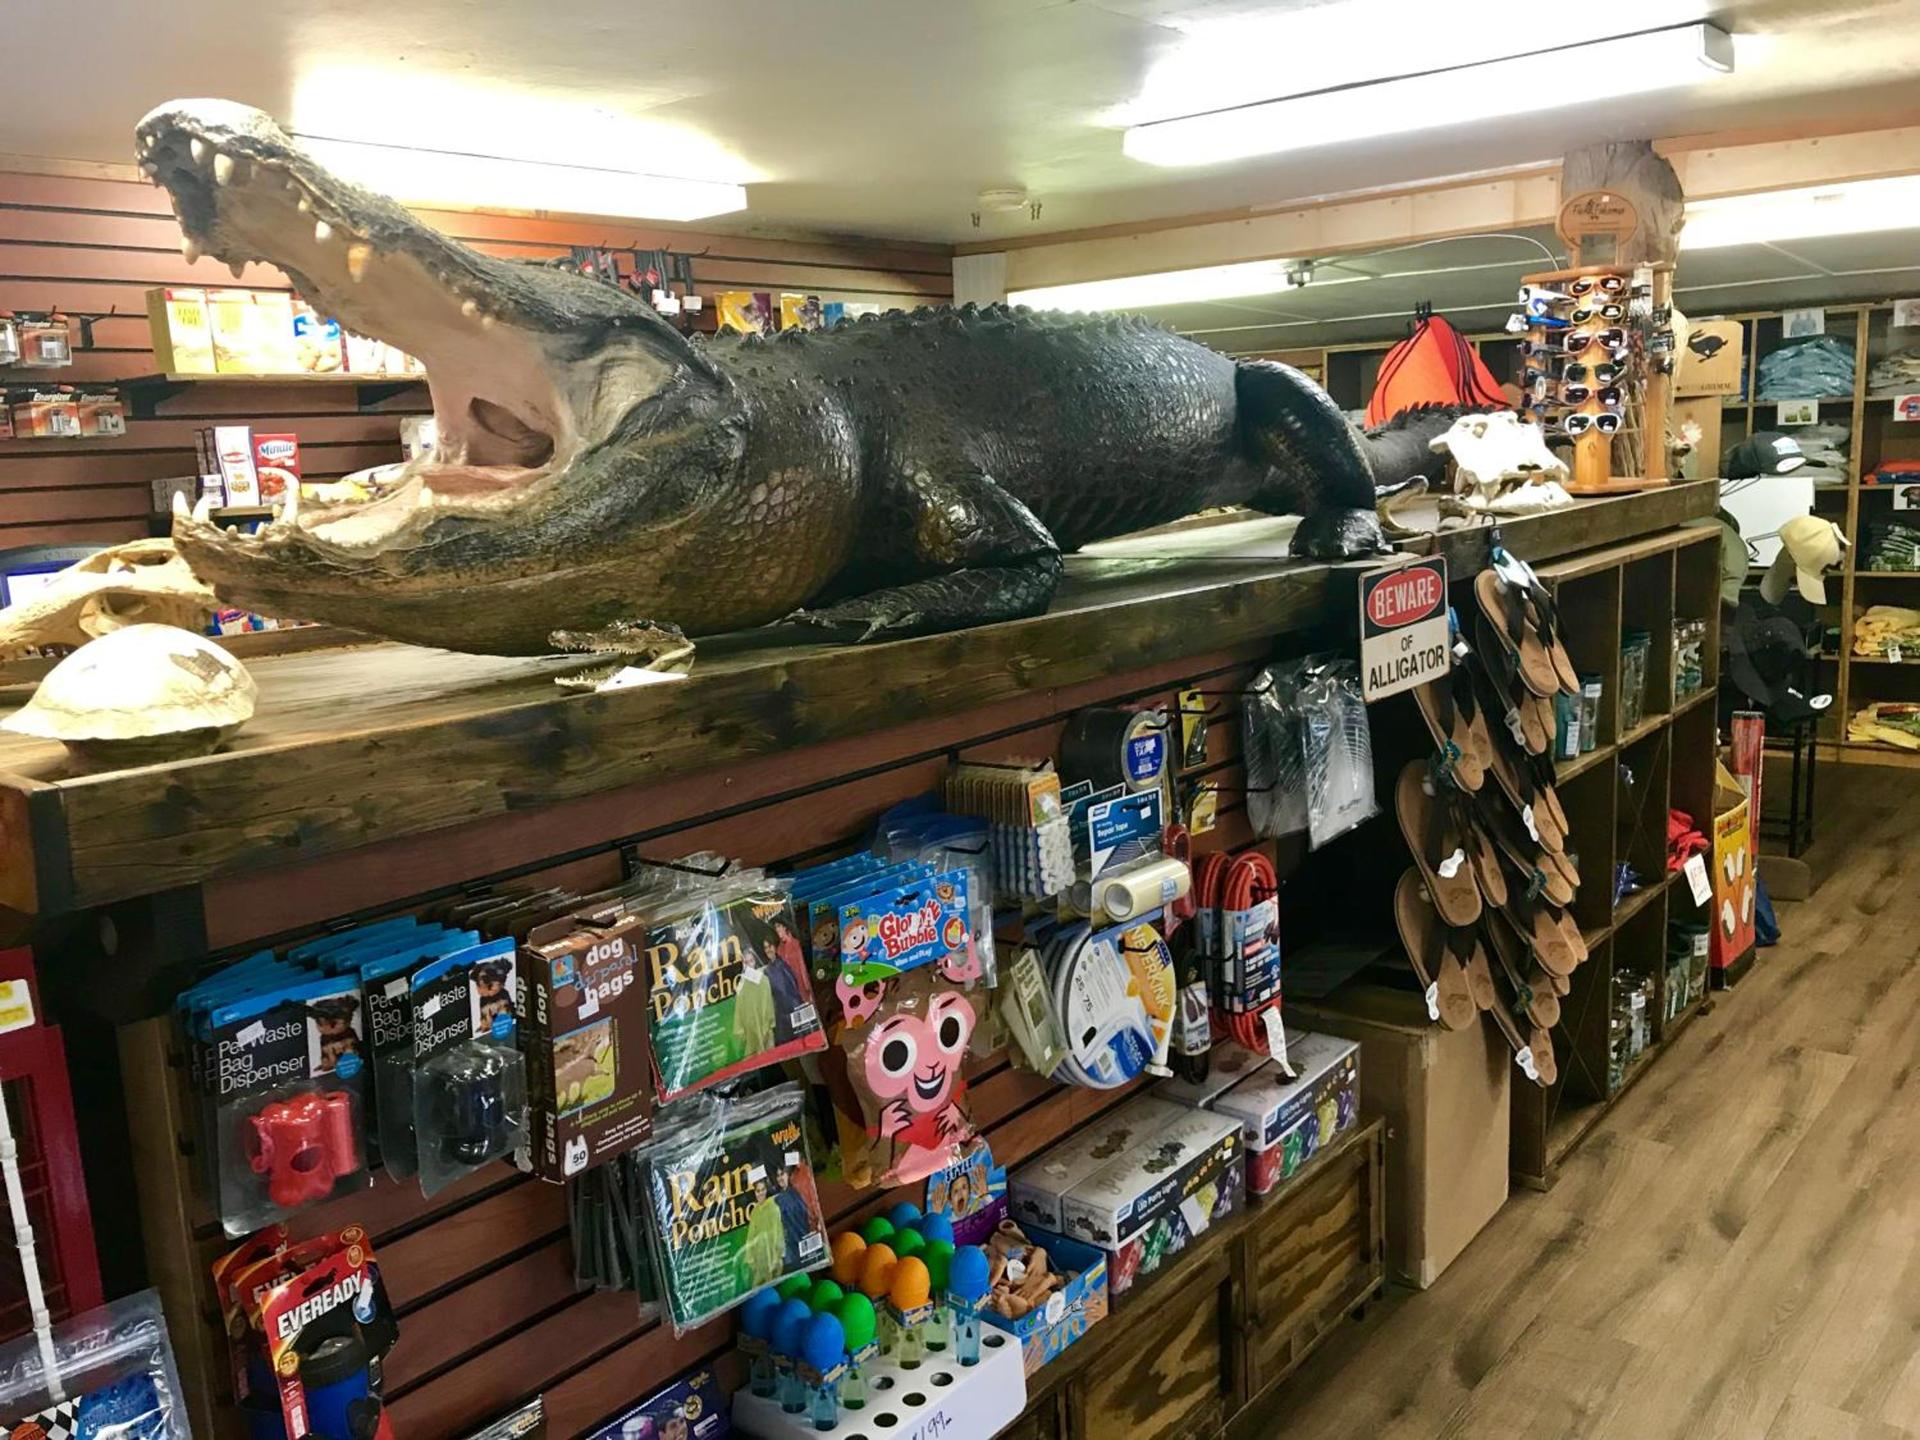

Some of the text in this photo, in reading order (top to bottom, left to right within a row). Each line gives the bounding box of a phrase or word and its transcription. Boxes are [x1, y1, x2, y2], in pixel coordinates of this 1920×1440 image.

[1374, 575, 1436, 620] BEWARE
[1400, 634, 1414, 652] OF
[1368, 644, 1445, 692] ALLIGATOR
[585, 937, 624, 967] dog
[885, 928, 937, 957] Bubble
[584, 969, 635, 1000] bags
[1127, 926, 1170, 1010] NEERKINK
[435, 985, 467, 1008] aste
[536, 983, 548, 1025] dog
[651, 968, 742, 1024] Poncho
[372, 1009, 401, 1029] Bag
[374, 1021, 414, 1046] Dispe
[414, 1019, 434, 1040] Bag
[414, 1017, 470, 1058] Dispenser
[219, 1053, 253, 1077] Bag
[220, 1055, 306, 1094] Dispenser
[545, 1110, 556, 1165] bags
[572, 1150, 586, 1163] 50
[946, 1157, 973, 1182] STYLE
[668, 1155, 757, 1218] Rain
[671, 1198, 757, 1251] Poncho
[277, 1270, 362, 1340] EVEREADY
